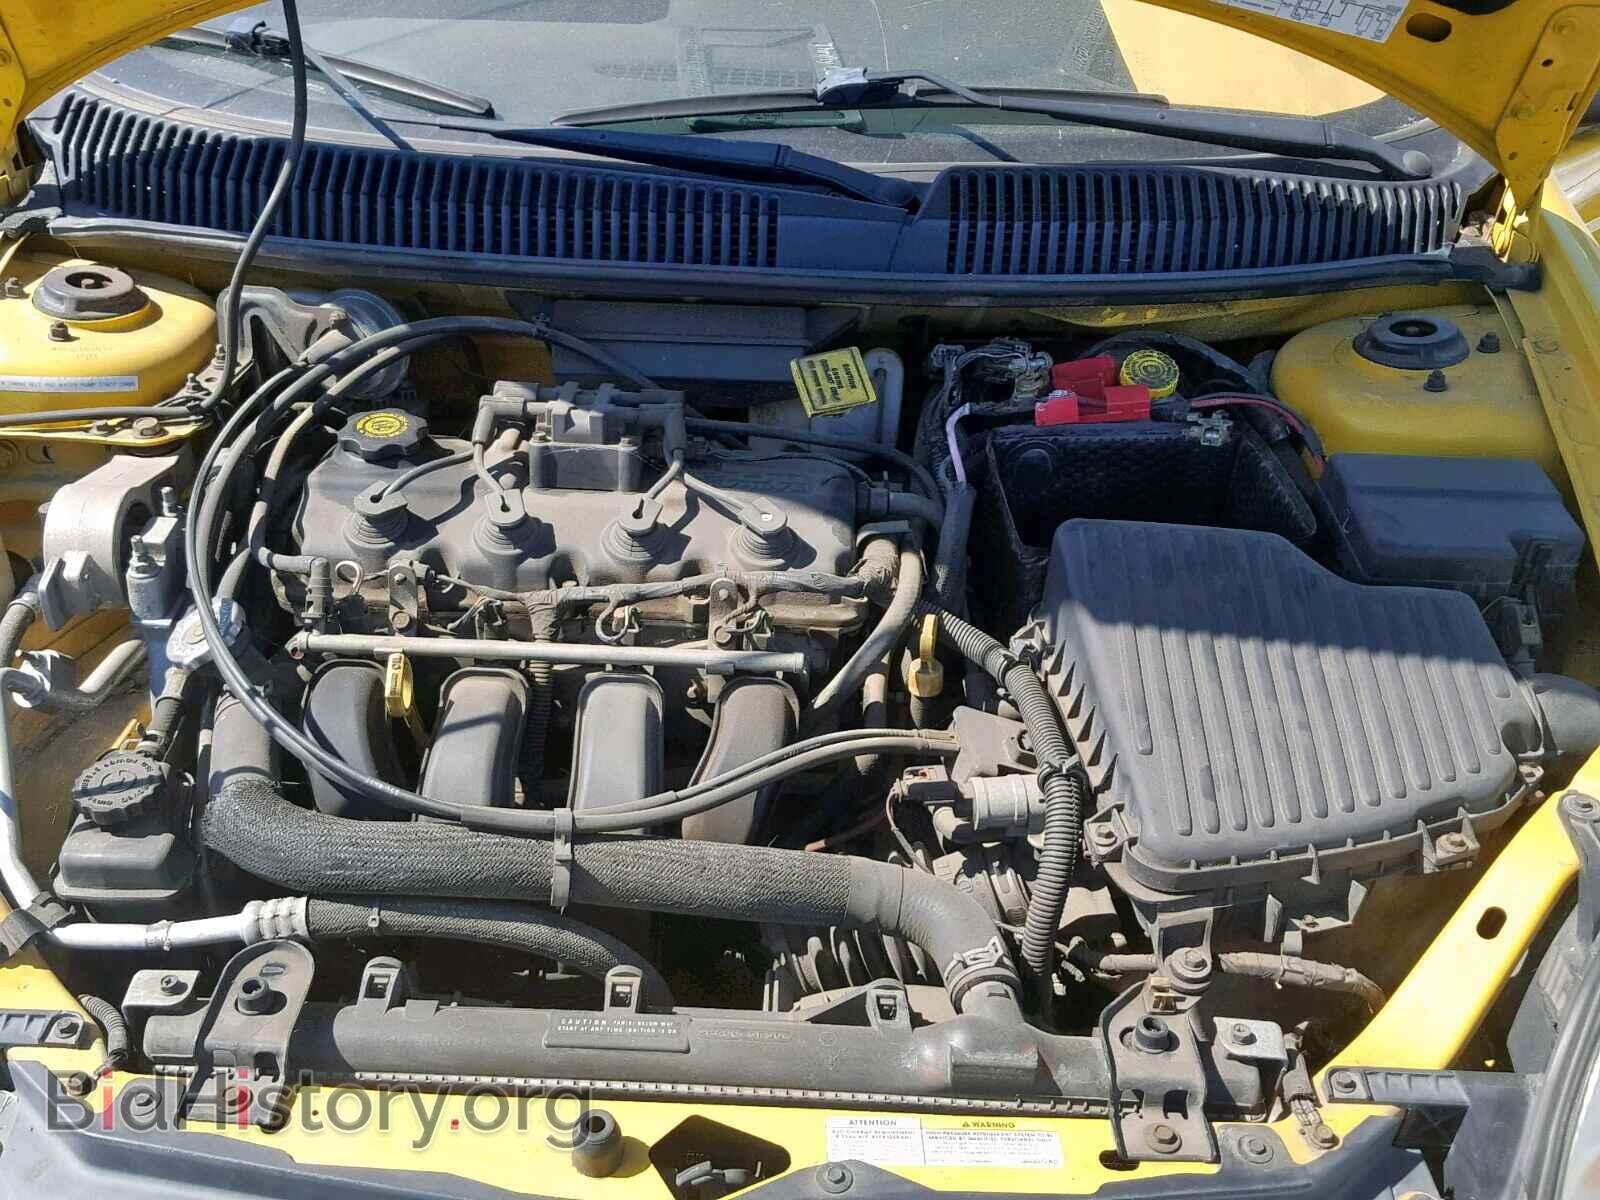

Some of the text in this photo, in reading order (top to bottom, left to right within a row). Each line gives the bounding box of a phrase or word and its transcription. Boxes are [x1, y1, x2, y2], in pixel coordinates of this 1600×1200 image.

[560, 1017, 607, 1026] CAUTION
[848, 1119, 897, 1127] ATTENTION
[972, 1120, 1016, 1129] WARNING
